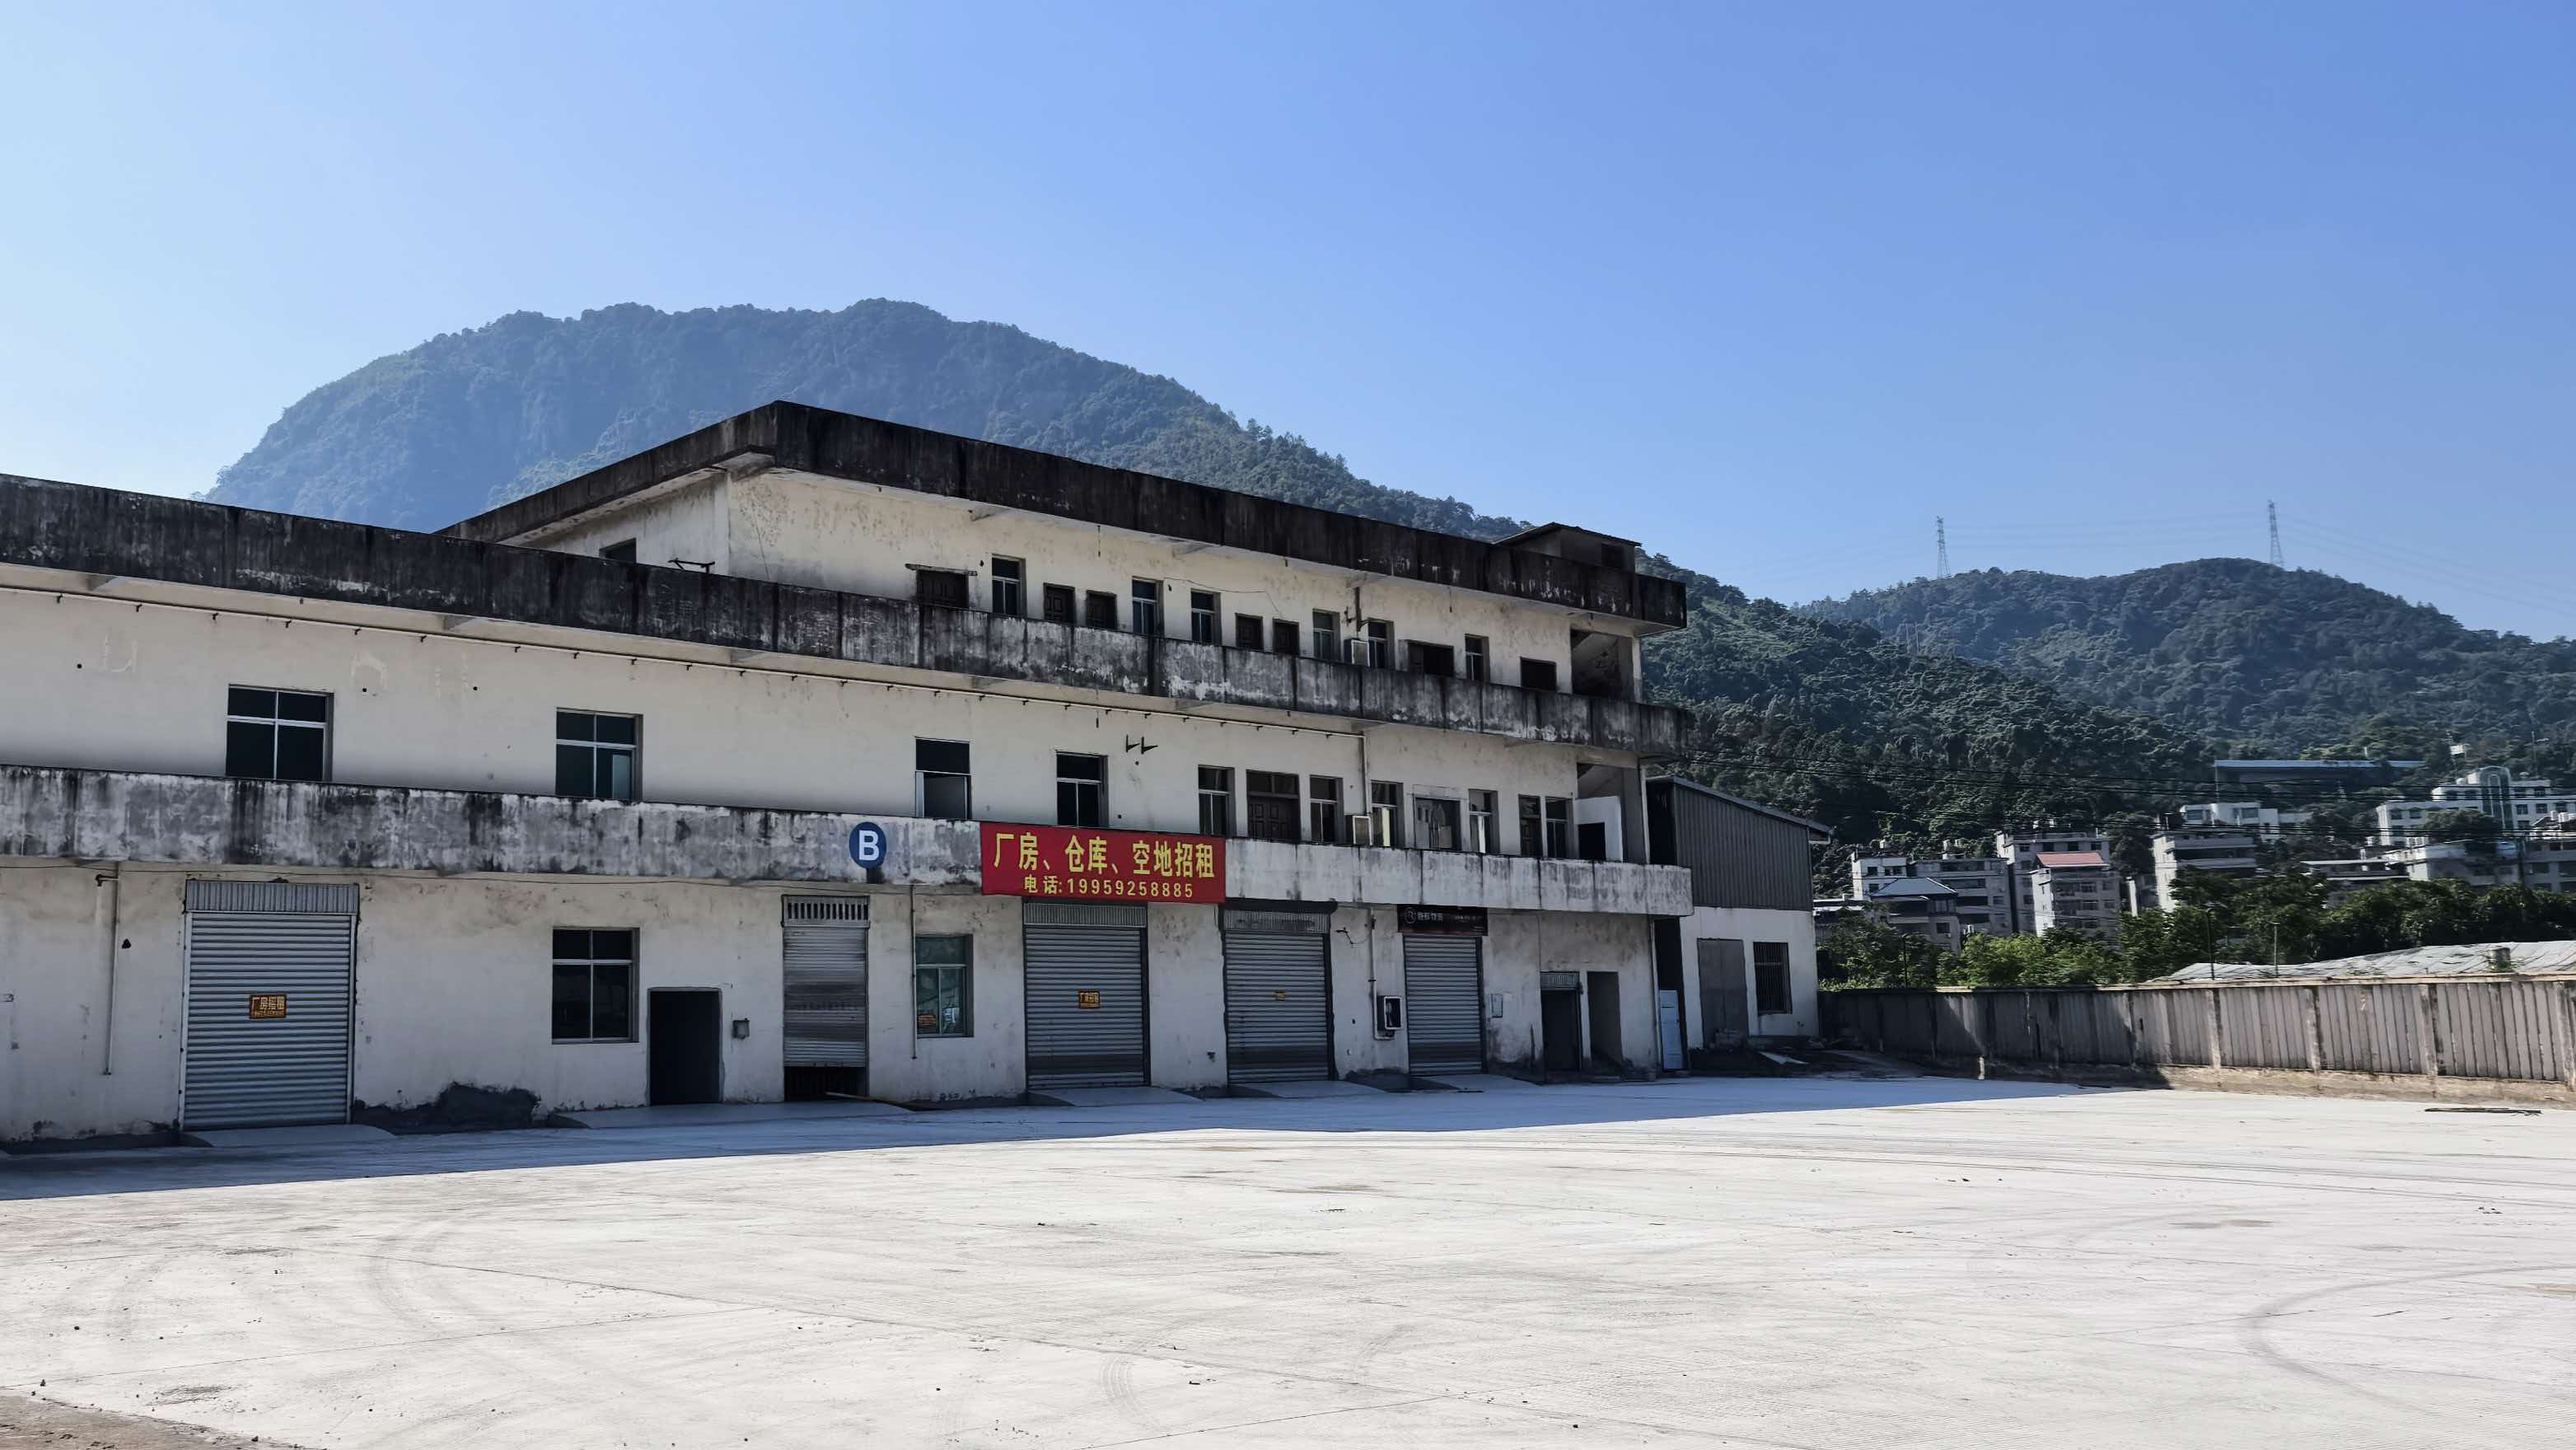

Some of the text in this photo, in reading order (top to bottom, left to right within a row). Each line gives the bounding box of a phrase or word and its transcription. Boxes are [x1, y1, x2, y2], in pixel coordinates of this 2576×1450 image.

[859, 830, 879, 861] B
[993, 831, 1215, 878] 厂房、仓库、空地招租
